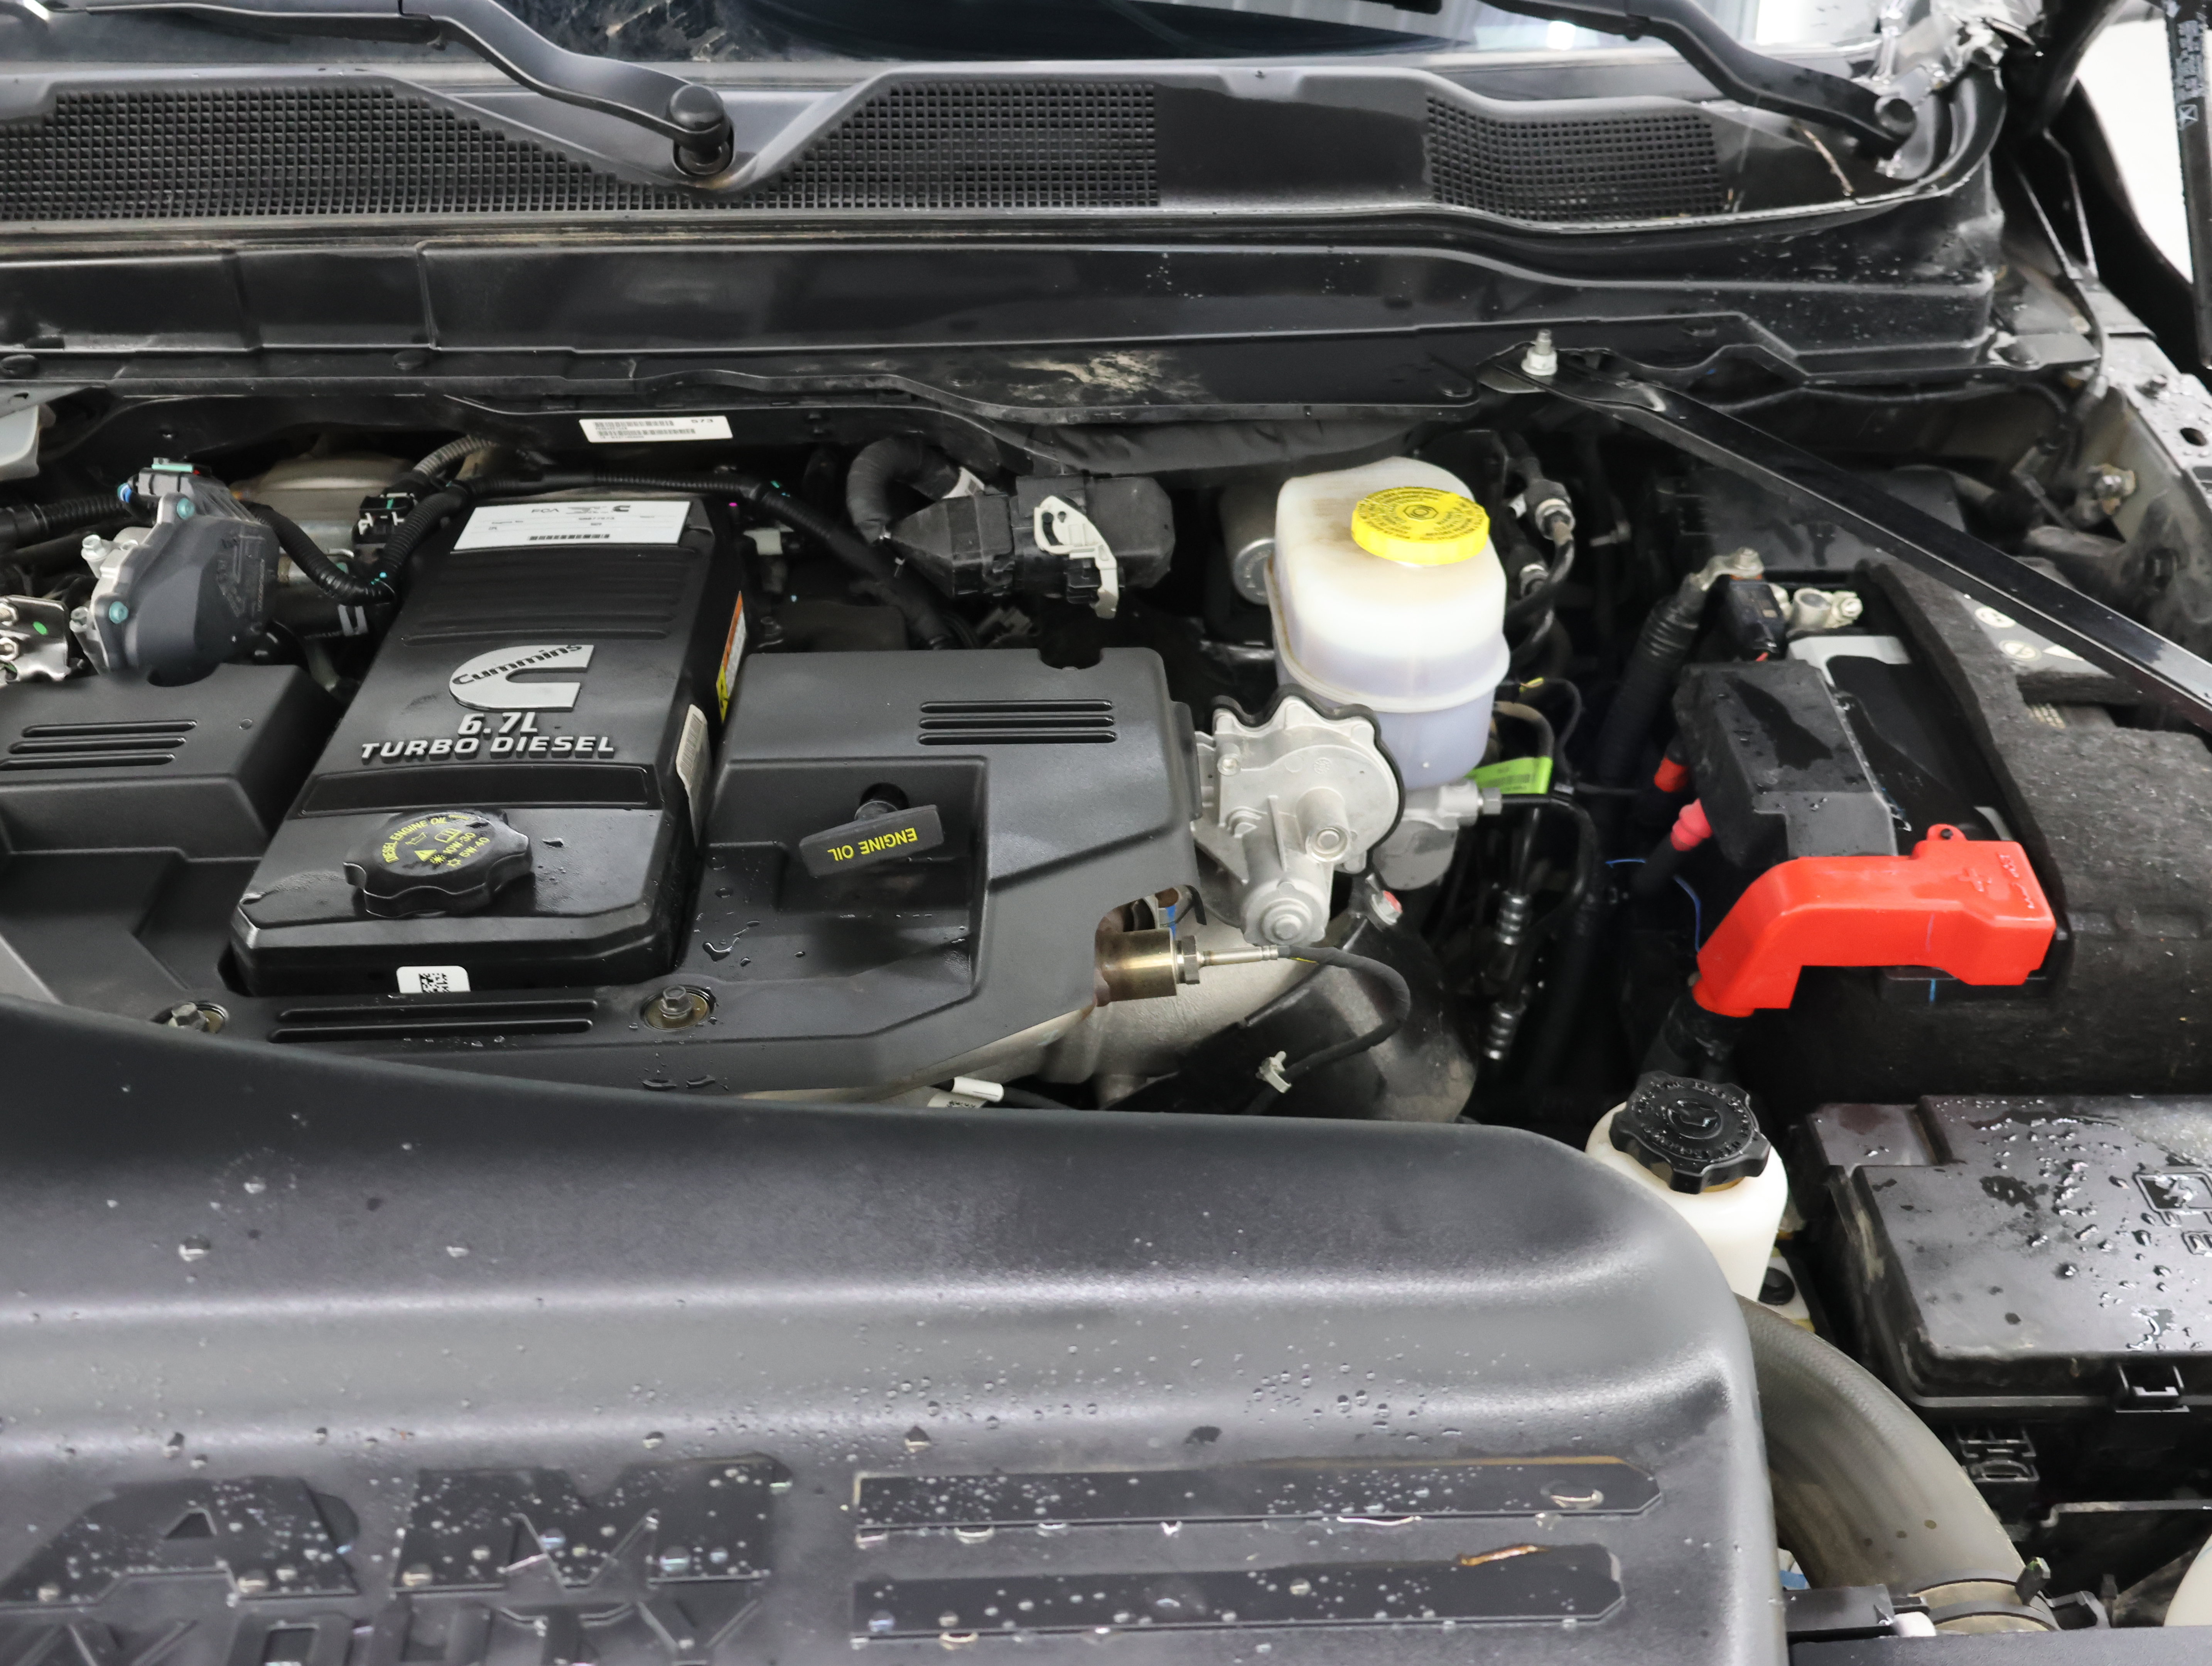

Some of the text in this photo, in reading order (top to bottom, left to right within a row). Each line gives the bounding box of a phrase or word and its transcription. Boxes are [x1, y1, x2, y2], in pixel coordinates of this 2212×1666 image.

[452, 643, 583, 685] Cummins
[457, 712, 538, 736] 6.7L
[361, 736, 615, 760] TURBO DIESEL
[382, 817, 447, 863] DIESEL ENGINE OIL
[443, 832, 477, 854] 10W-30
[827, 827, 918, 861] ENGINE OIL
[0, 1462, 768, 1612] AM
